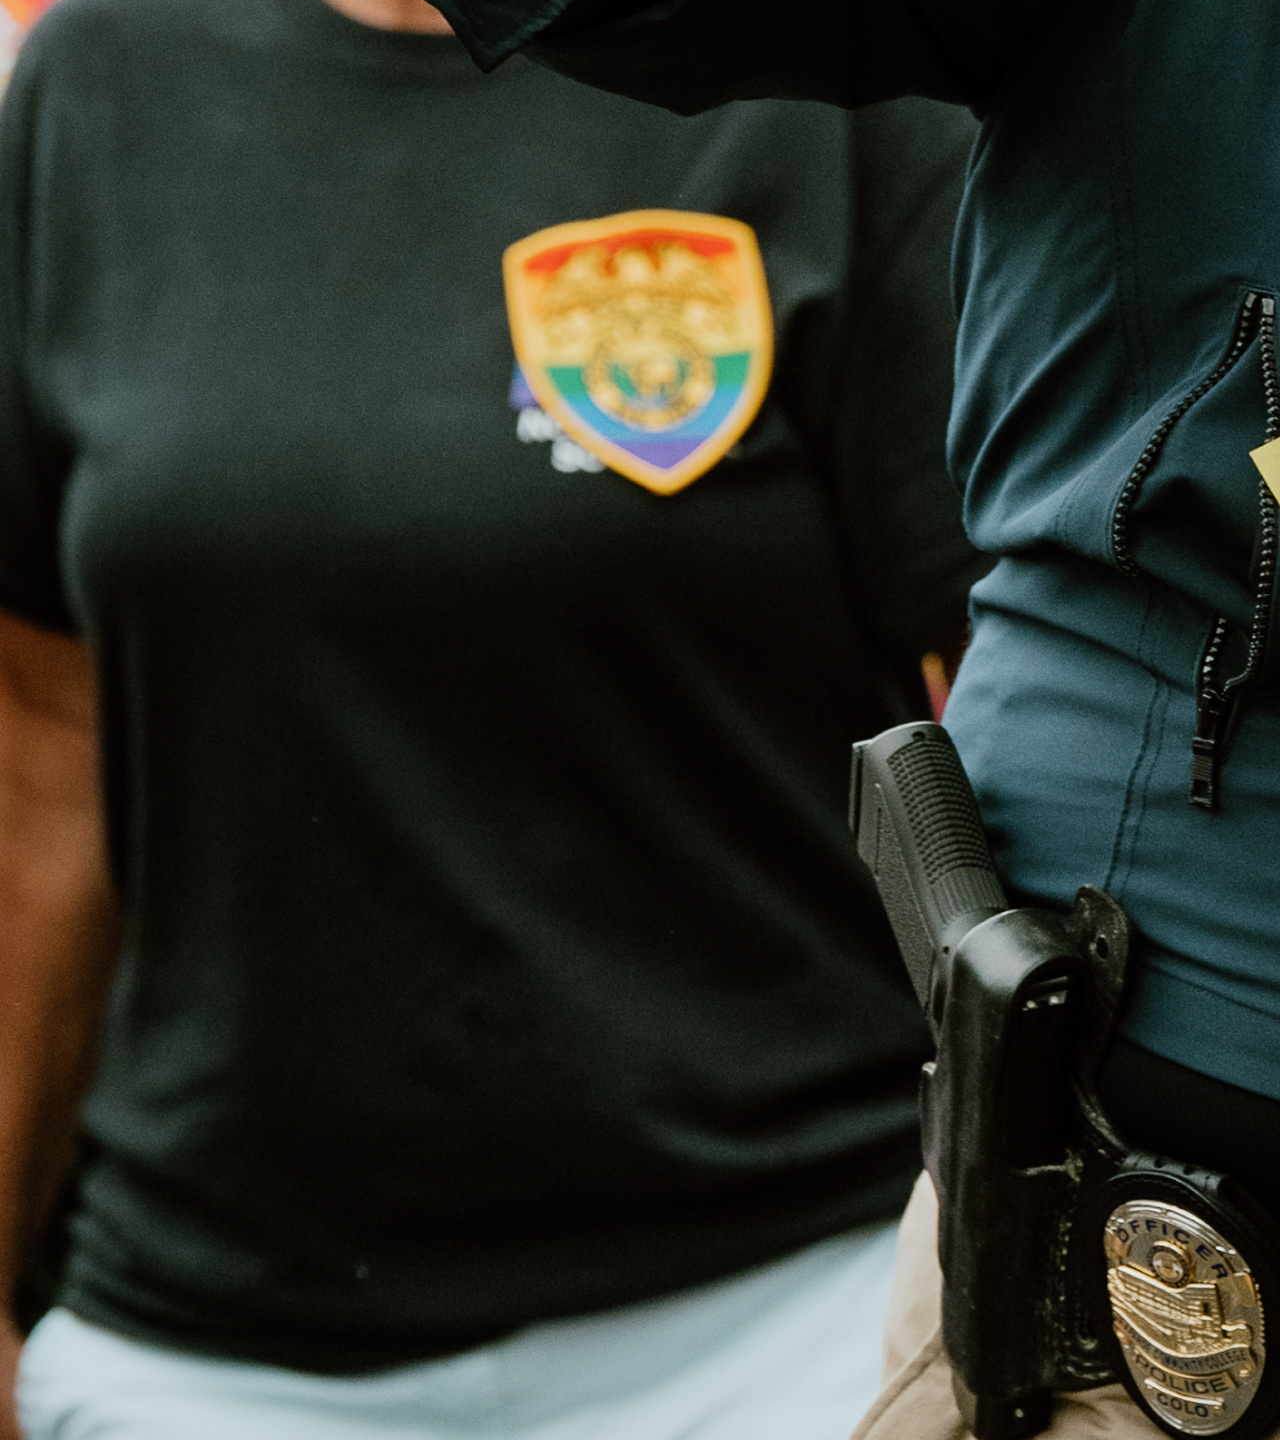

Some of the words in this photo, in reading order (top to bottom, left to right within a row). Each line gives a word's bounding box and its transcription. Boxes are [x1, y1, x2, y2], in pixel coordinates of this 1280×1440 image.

[1116, 1219, 1228, 1279] OFFICER
[1135, 1354, 1229, 1395] POLICE
[1156, 1392, 1209, 1418] COLO
